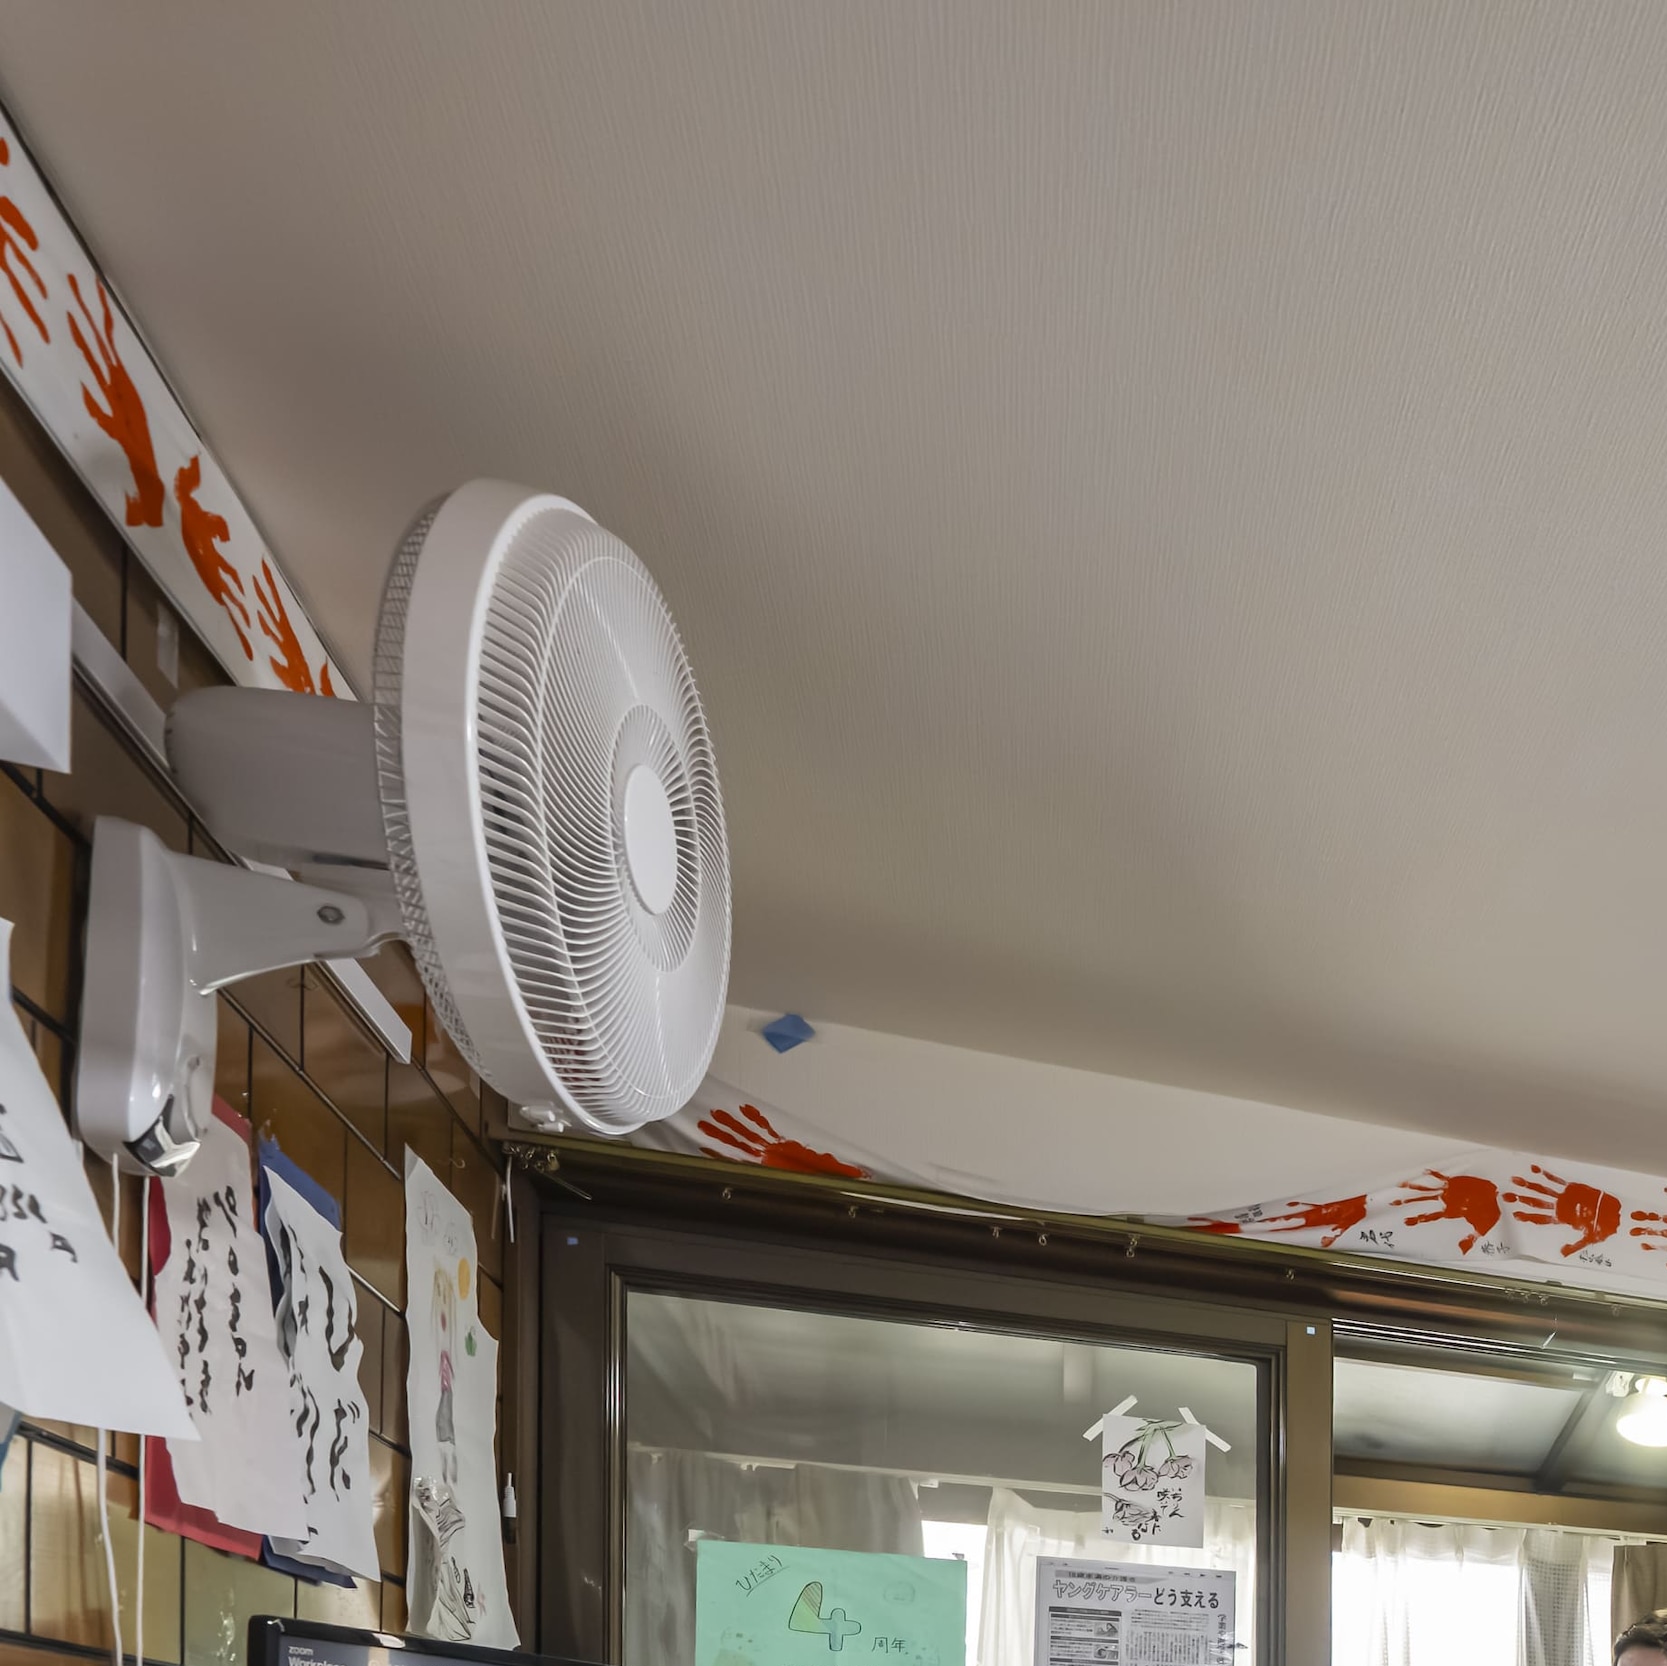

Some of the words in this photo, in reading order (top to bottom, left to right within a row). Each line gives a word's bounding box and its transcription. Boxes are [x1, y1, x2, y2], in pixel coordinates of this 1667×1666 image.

[735, 1554, 783, 1591] ひだまり
[1052, 1579, 1220, 1609] ヤングケアラーどう支える
[788, 1581, 862, 1652] 4
[288, 1645, 314, 1657] zoom
